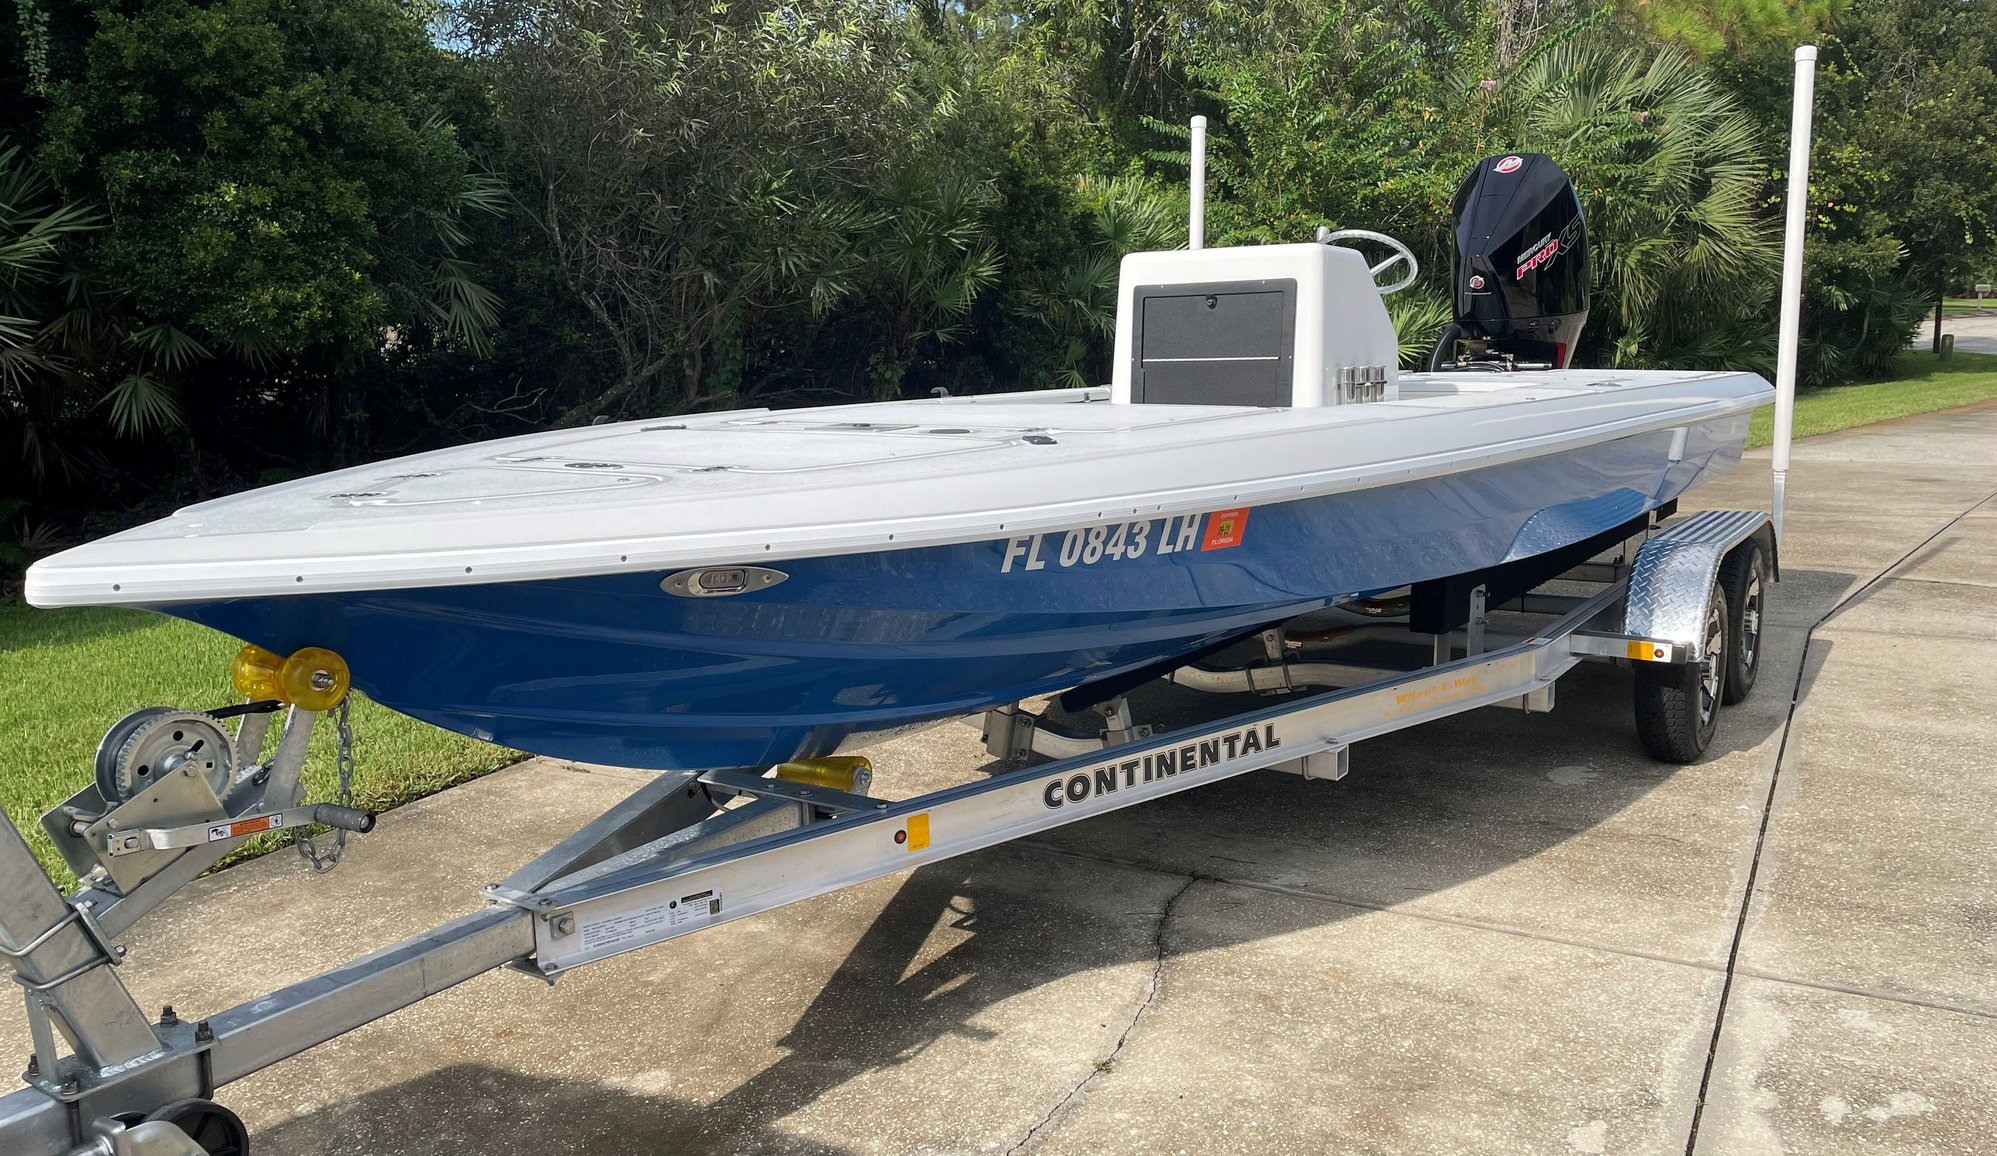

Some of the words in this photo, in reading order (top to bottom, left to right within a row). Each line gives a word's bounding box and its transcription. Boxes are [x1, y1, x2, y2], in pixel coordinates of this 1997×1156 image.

[1516, 239, 1559, 281] PRO
[1517, 232, 1552, 264] MERCURY
[1001, 534, 1045, 573] FL
[1059, 520, 1151, 567] 0843
[1157, 513, 1202, 554] LH
[1211, 536, 1234, 546] FLORIDA
[1042, 723, 1281, 809] CONTINENTAL
